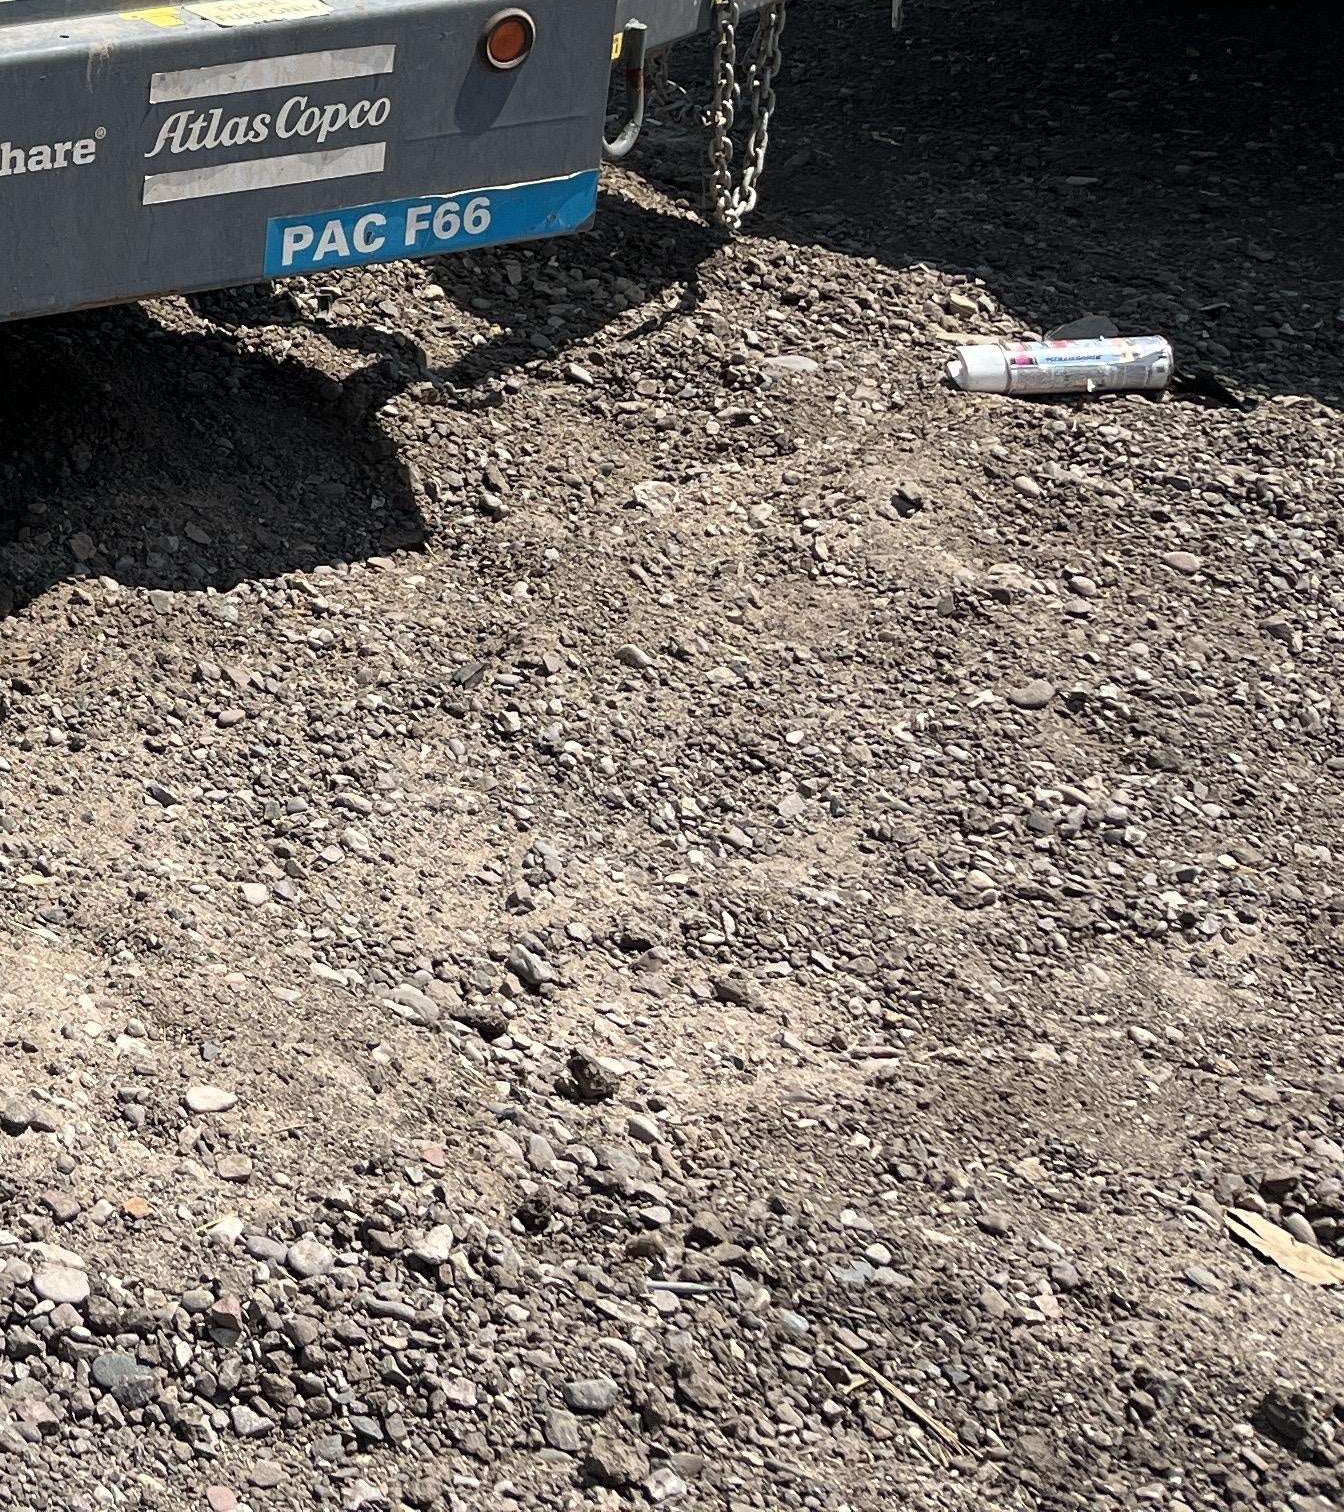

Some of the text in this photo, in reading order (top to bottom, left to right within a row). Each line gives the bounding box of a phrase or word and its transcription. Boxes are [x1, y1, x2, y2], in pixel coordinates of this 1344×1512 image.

[143, 96, 391, 158] Atlas Copco
[280, 196, 492, 266] PAC F66
